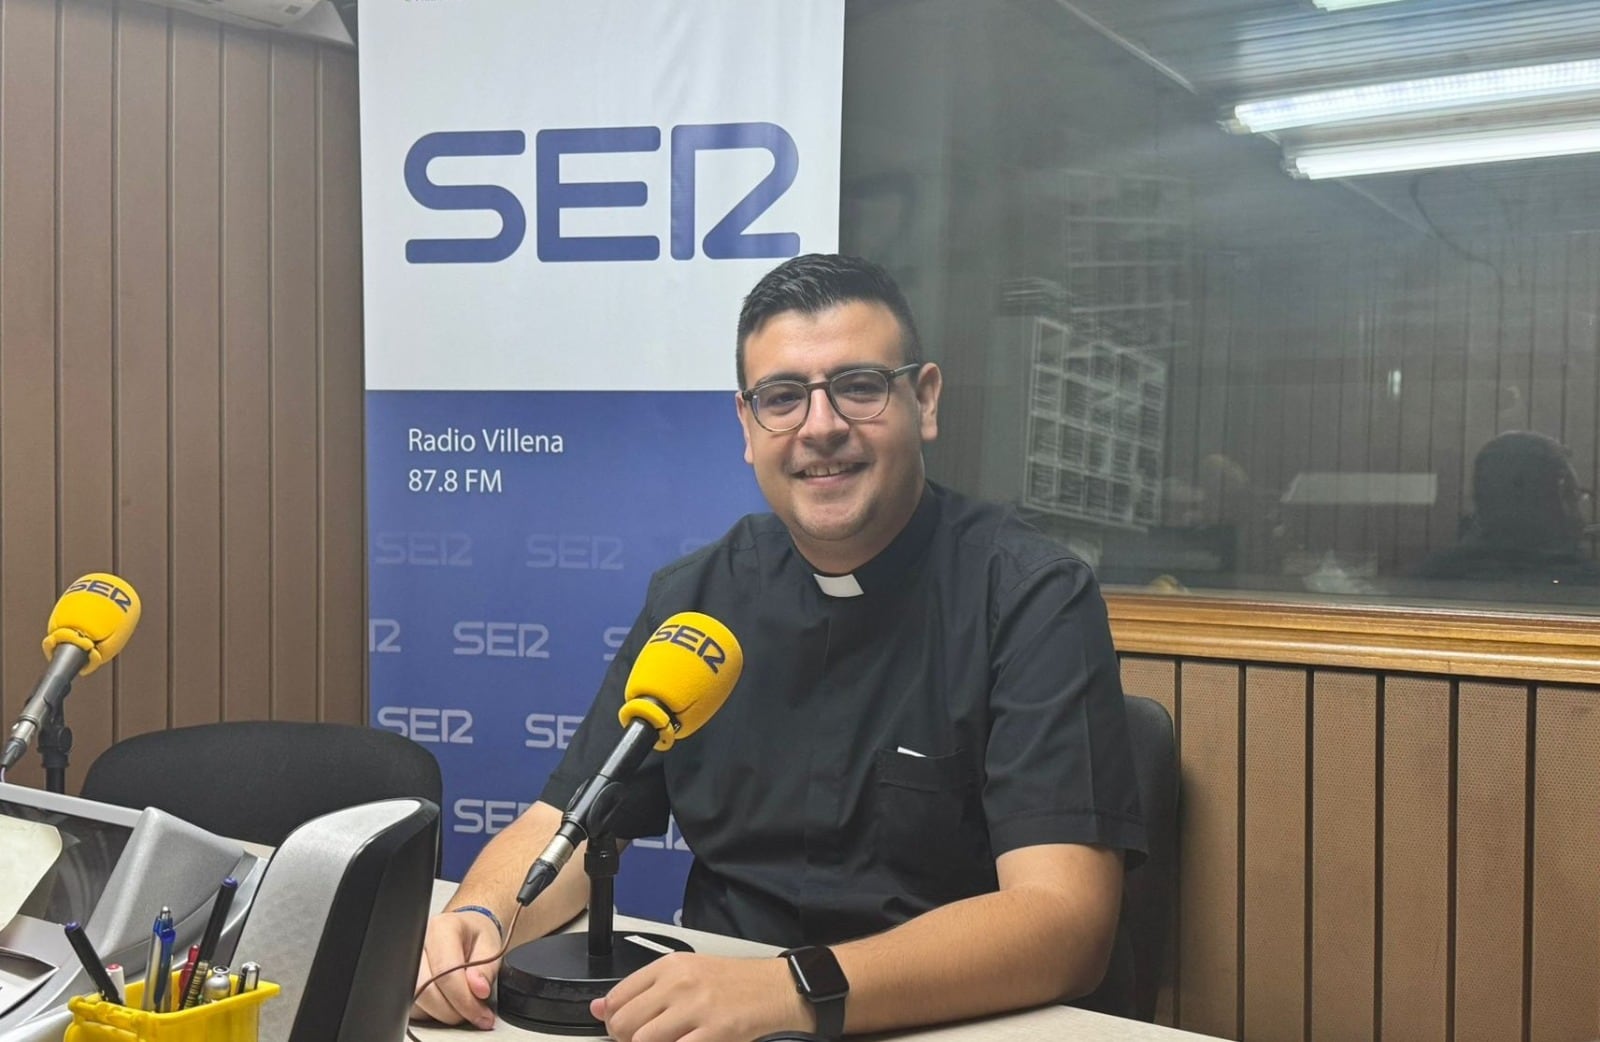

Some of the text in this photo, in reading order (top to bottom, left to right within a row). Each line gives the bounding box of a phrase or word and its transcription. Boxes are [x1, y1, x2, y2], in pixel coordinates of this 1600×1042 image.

[404, 122, 800, 264] SER
[408, 428, 564, 454] Radio Villena
[408, 469, 502, 494] 87.8 FM
[375, 531, 473, 567] SER
[525, 534, 624, 570] SER
[64, 579, 131, 613] SER
[453, 621, 550, 659] SER
[649, 624, 726, 674] SER
[377, 706, 473, 744] SER
[525, 713, 585, 750] SE
[453, 799, 531, 835] SE
